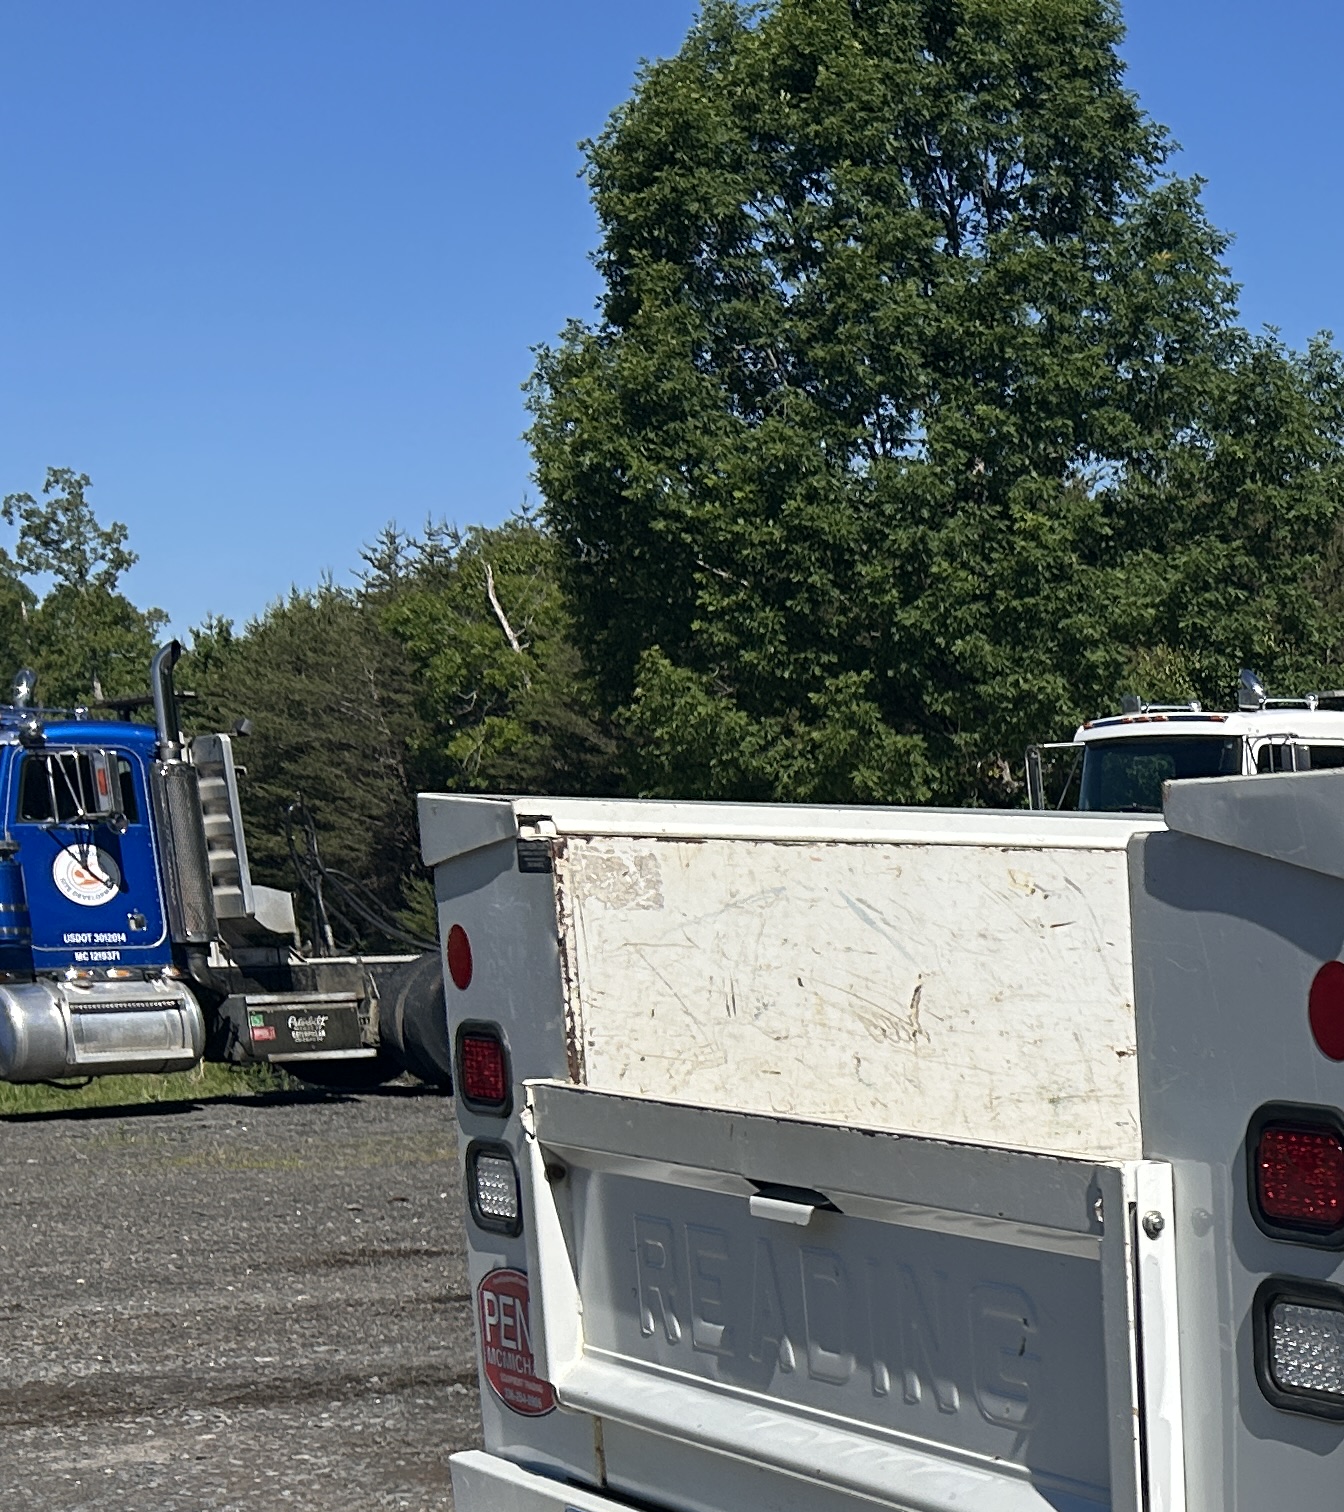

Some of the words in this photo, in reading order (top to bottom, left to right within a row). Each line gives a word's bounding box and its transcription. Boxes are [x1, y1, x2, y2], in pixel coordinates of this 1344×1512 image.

[483, 1290, 533, 1354] PEN
[632, 1213, 1043, 1430] READING
[486, 1345, 536, 1376] MCMICH
